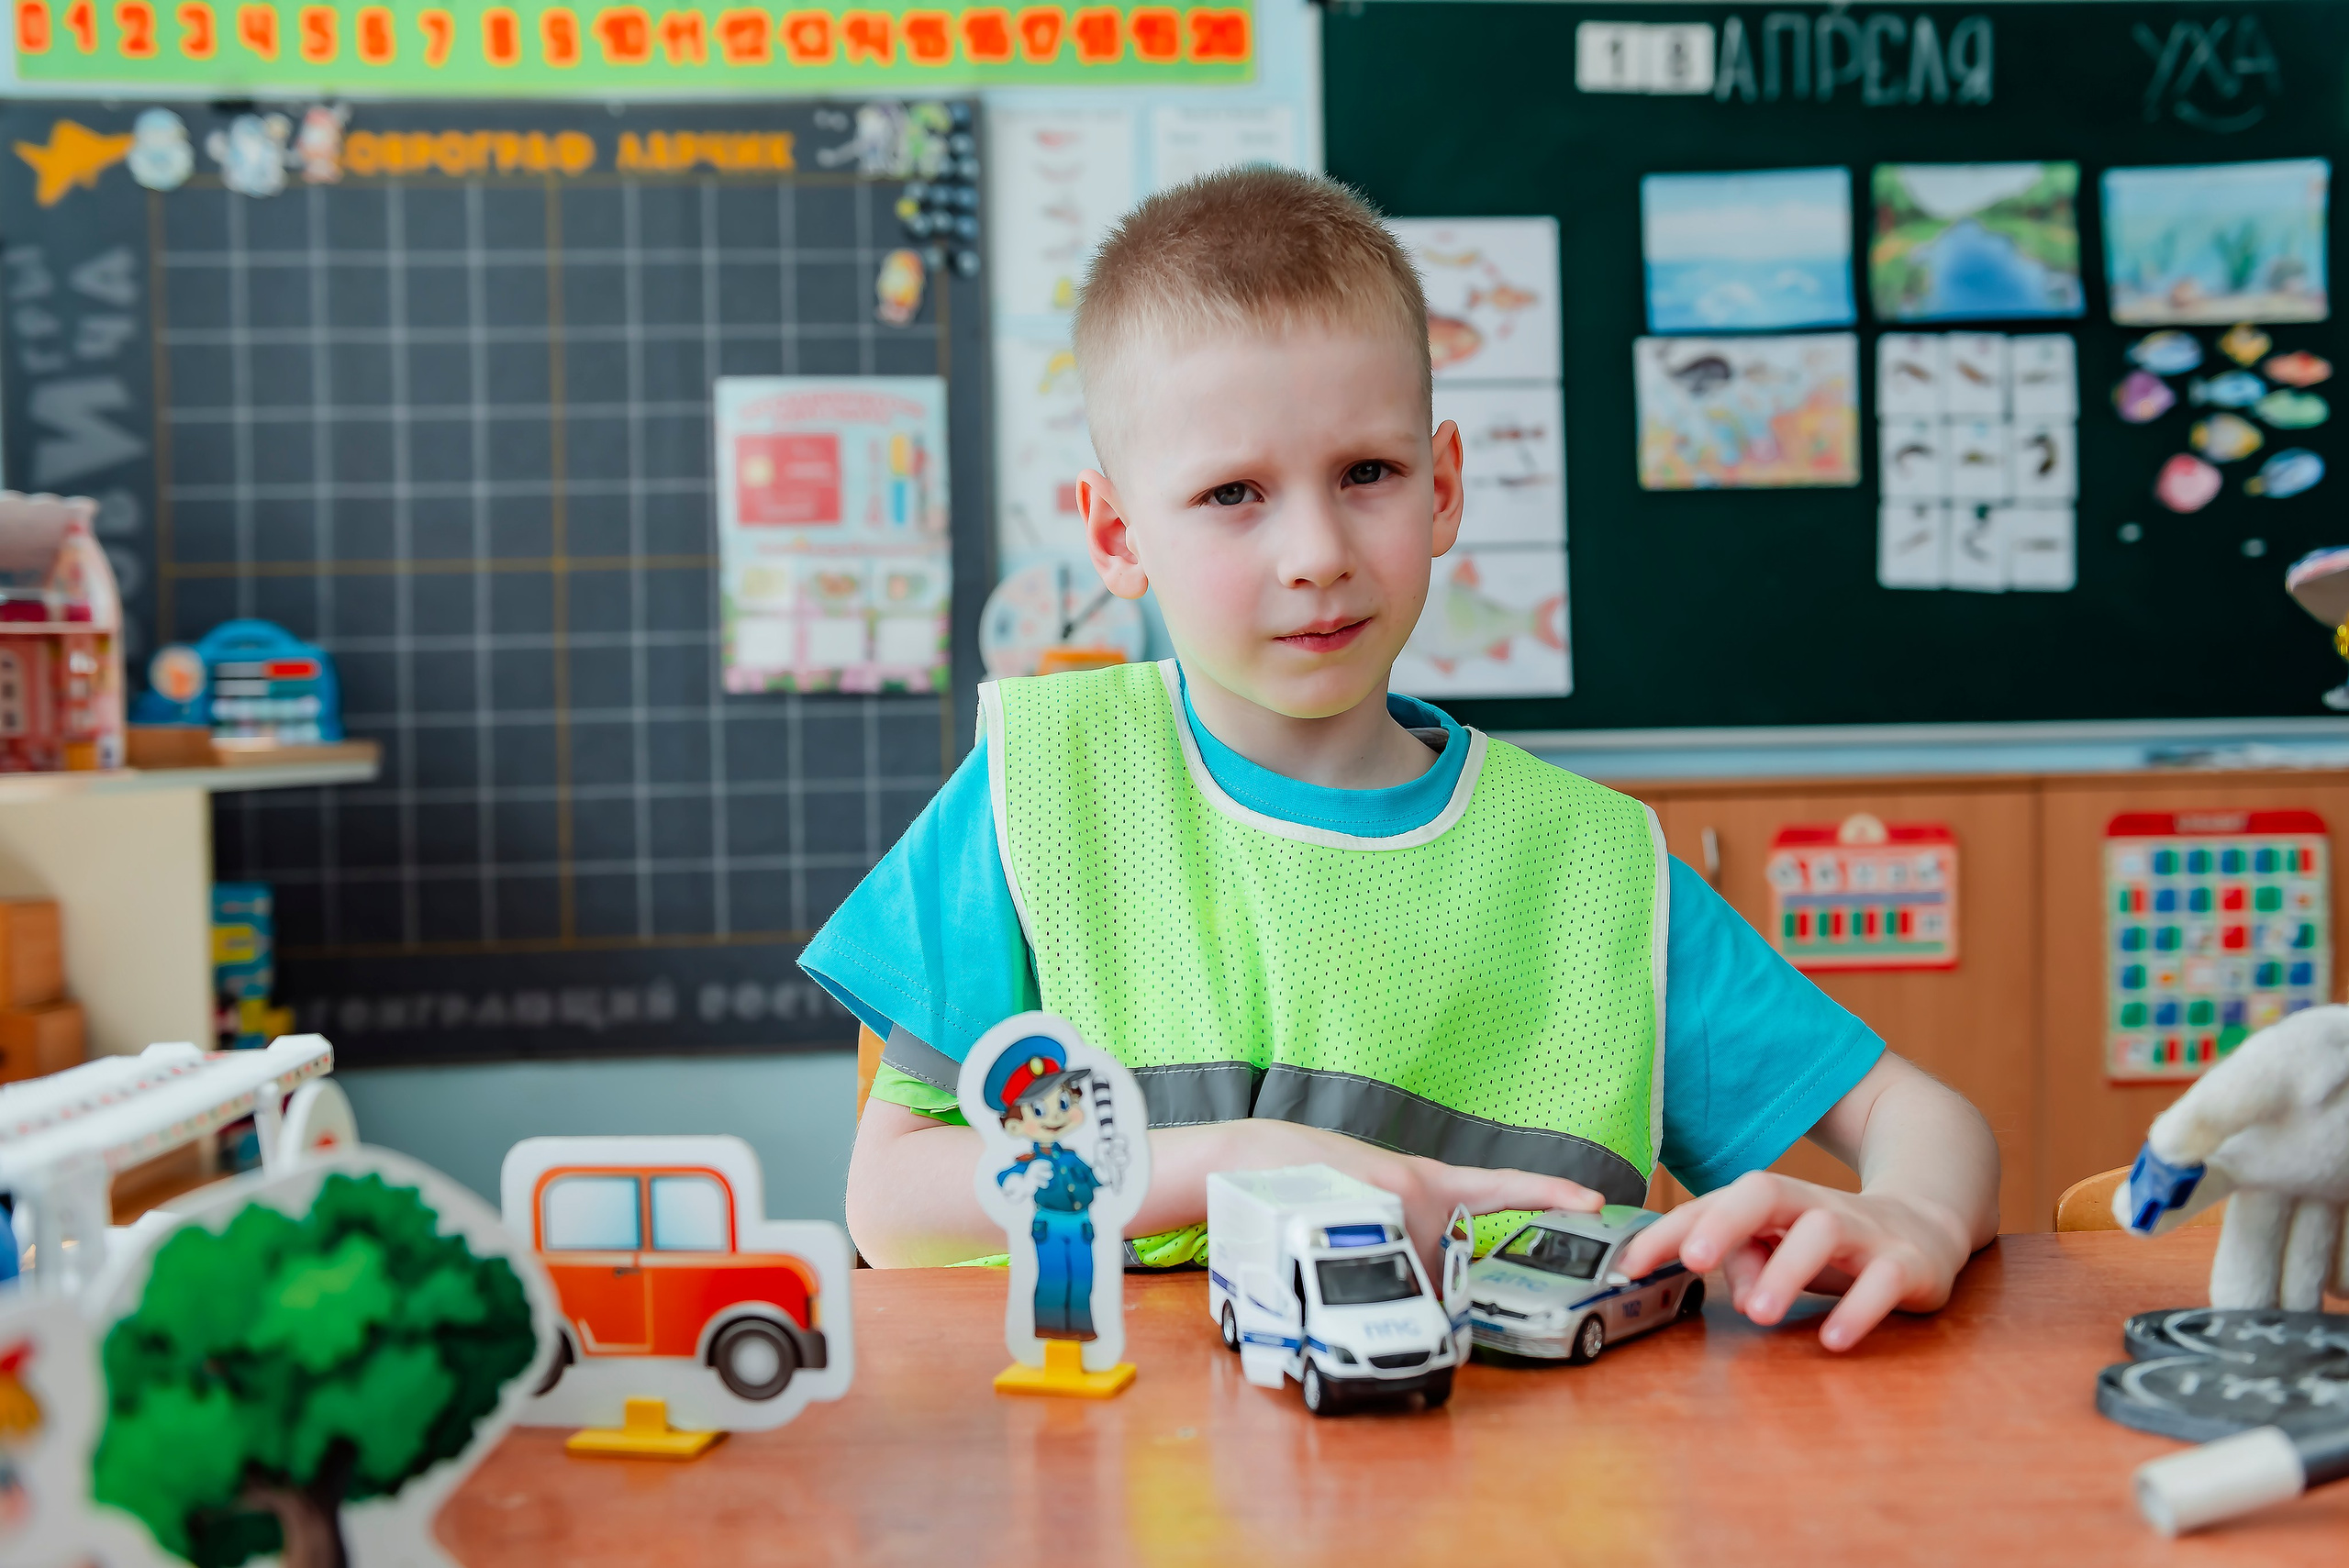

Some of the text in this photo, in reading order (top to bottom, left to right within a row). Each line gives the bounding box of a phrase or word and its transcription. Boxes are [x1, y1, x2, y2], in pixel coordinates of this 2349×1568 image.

[63, 0, 97, 54] 1
[115, 0, 158, 59] 2
[177, 2, 217, 60] 3
[238, 5, 278, 61] 4
[300, 6, 338, 64] 5
[357, 7, 395, 65] 6
[418, 10, 454, 66] 7
[483, 8, 520, 67] 8
[540, 8, 580, 67] 9
[591, 6, 654, 65] 10
[655, 8, 707, 66] 11
[714, 7, 774, 65] 12
[838, 8, 896, 66] 14
[1715, 11, 1994, 105] АПРЕЛЯ
[2132, 15, 2281, 122] УХА
